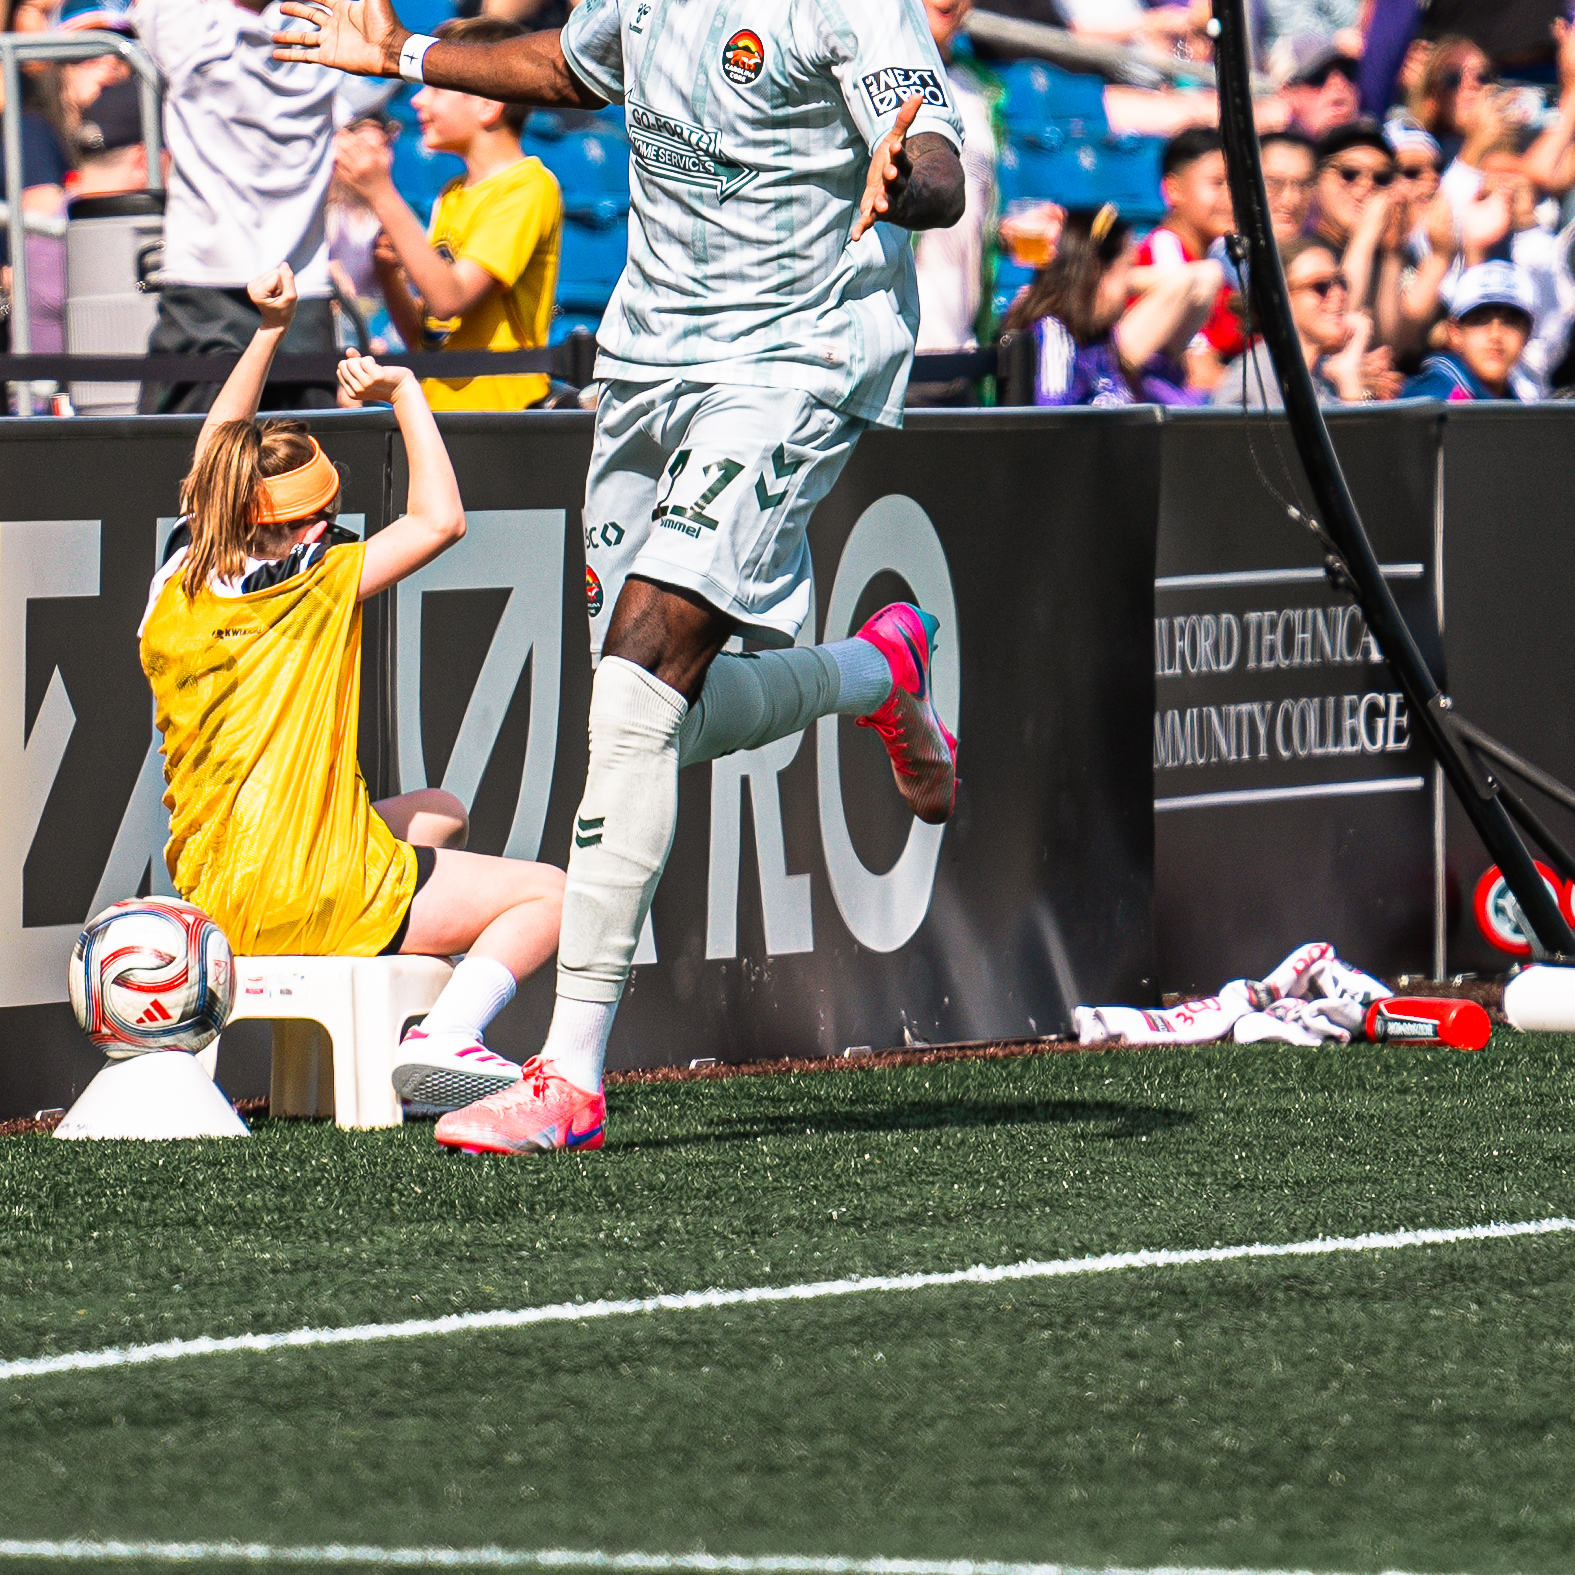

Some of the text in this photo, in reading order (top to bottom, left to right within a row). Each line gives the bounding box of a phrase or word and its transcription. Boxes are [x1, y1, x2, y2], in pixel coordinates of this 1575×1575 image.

[880, 68, 934, 92] NEXT
[658, 149, 715, 174] SERVICES
[660, 518, 702, 539] mmel
[1243, 603, 1385, 670] TECHNICA
[1275, 691, 1412, 760] COLLEGE
